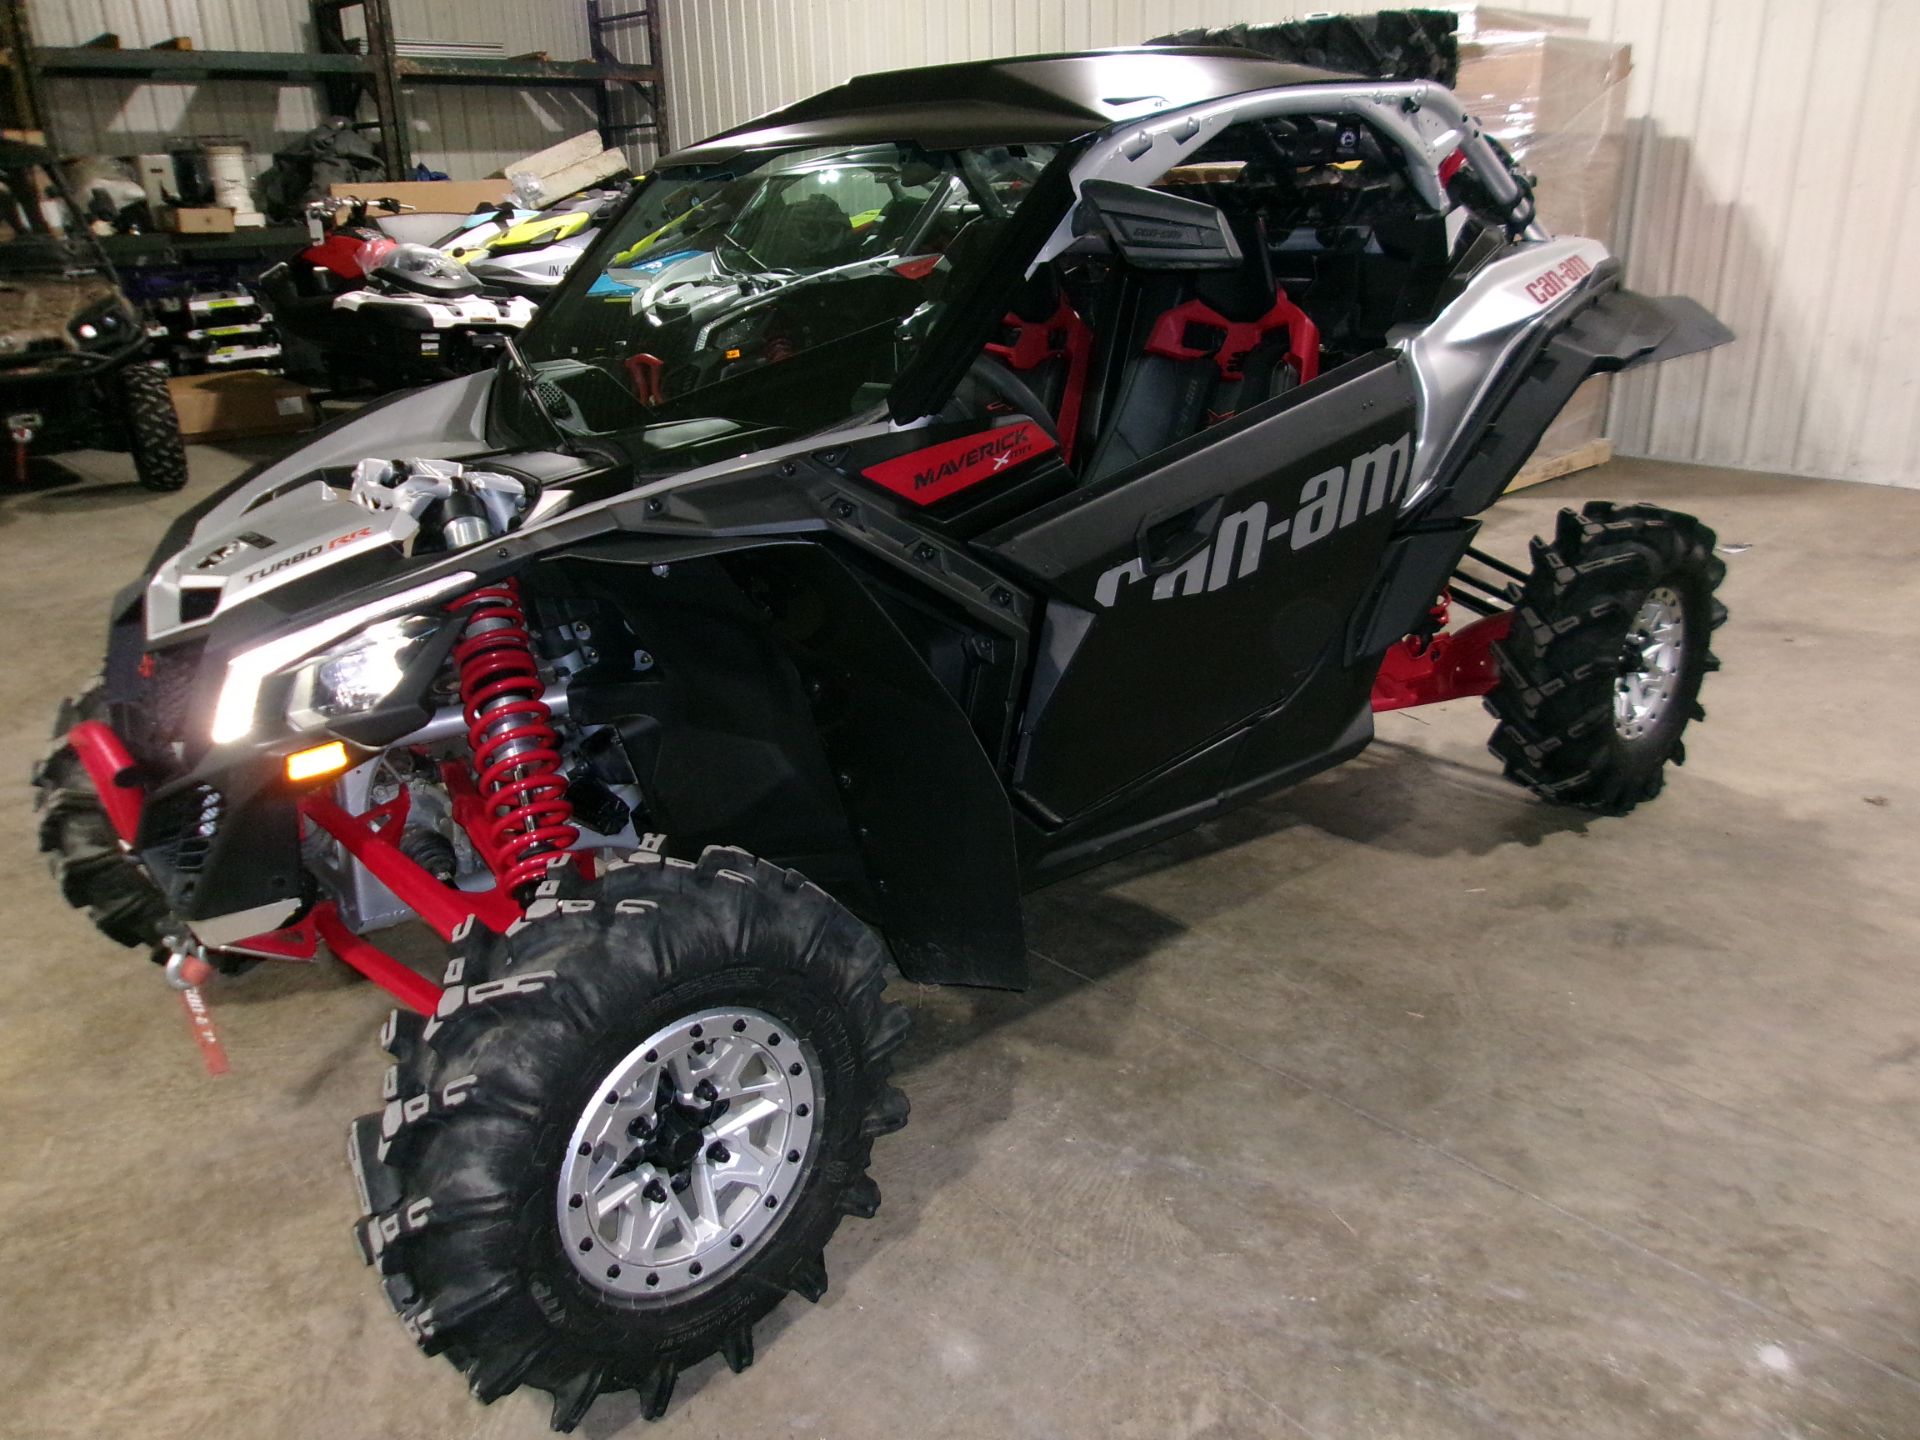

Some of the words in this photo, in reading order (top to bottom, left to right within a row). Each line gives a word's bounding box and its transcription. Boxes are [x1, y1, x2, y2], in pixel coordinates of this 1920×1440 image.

[548, 265, 559, 276] IN
[1525, 254, 1591, 304] can-am
[913, 426, 1029, 490] MAVERICK
[245, 545, 323, 583] TURBO
[328, 527, 372, 551] RR
